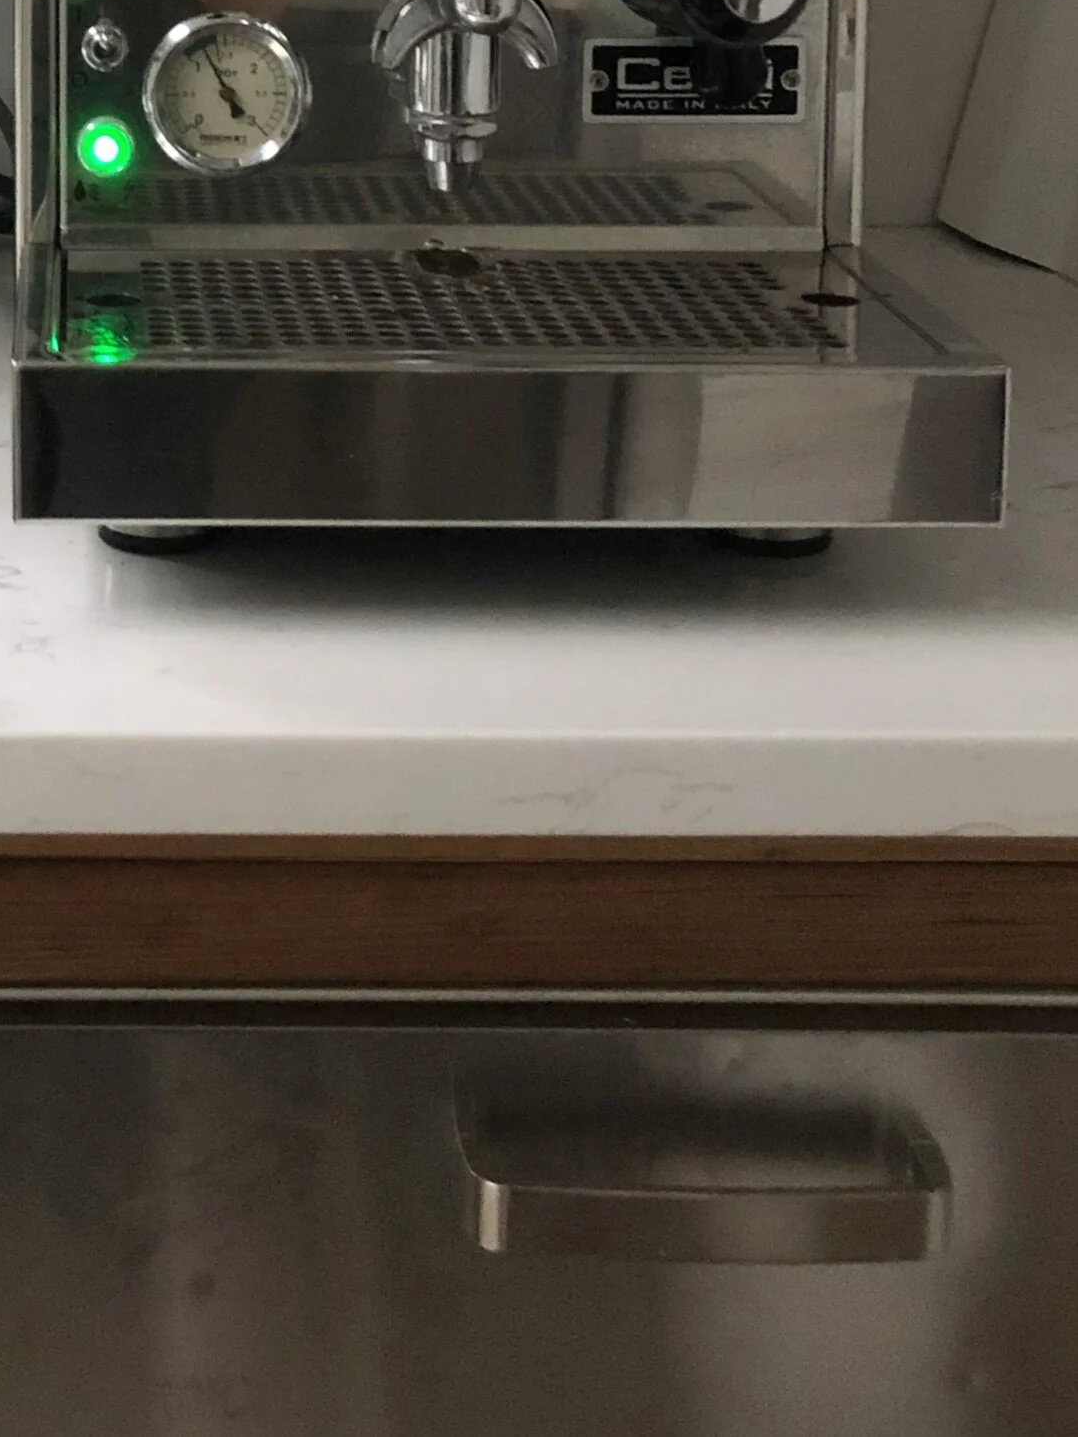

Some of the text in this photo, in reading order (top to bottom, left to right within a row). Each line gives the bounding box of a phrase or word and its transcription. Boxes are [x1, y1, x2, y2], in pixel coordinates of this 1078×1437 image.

[249, 63, 259, 74] 2
[615, 99, 674, 110] MADE
[684, 98, 706, 109] IN
